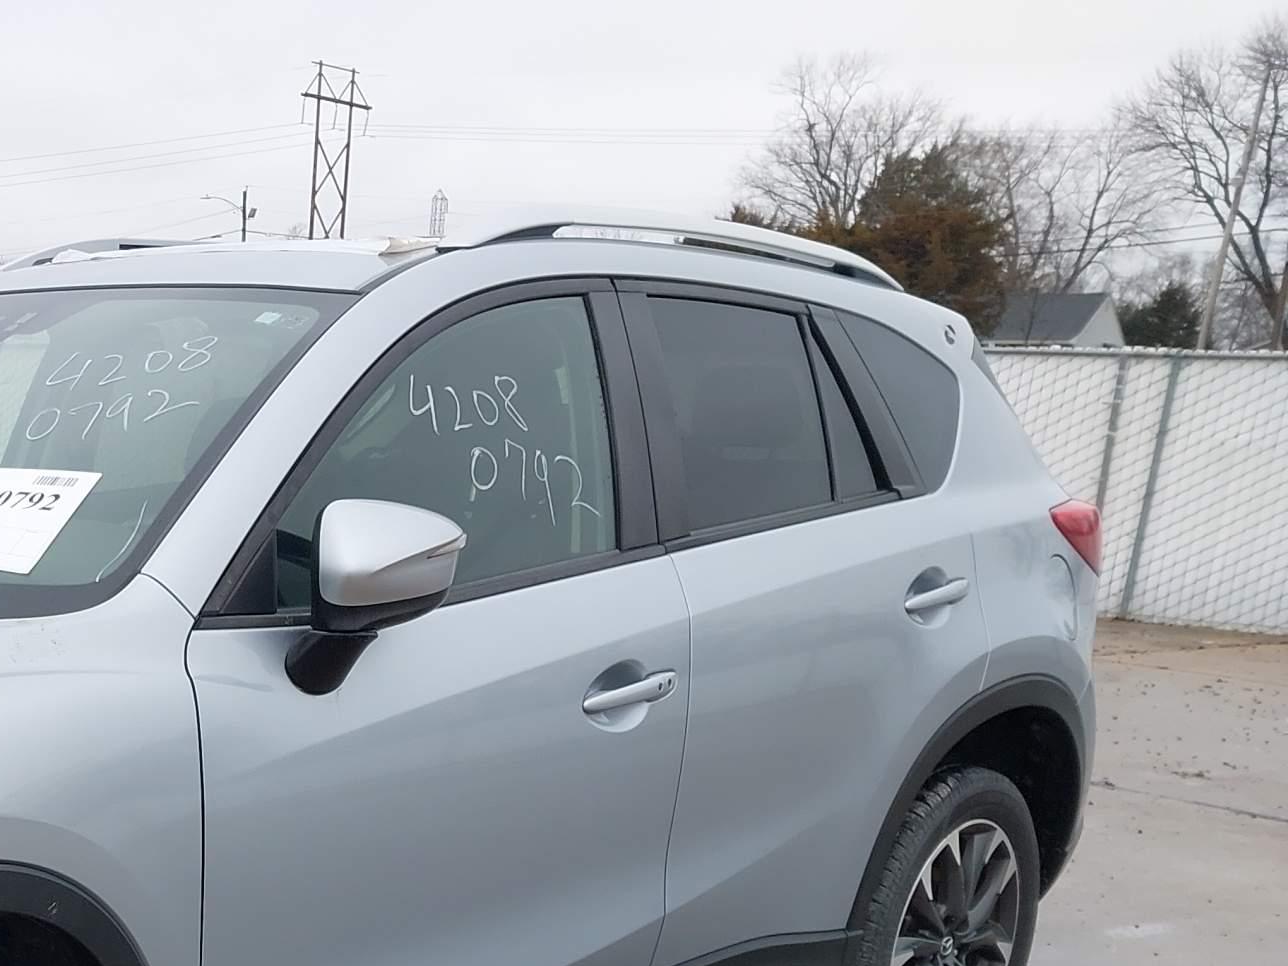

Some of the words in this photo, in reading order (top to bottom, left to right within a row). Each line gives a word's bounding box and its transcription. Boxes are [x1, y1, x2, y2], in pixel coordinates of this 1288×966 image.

[46, 335, 219, 391] 4208
[26, 389, 201, 441] 0792
[409, 374, 529, 436] 4208
[469, 438, 601, 527] 0792
